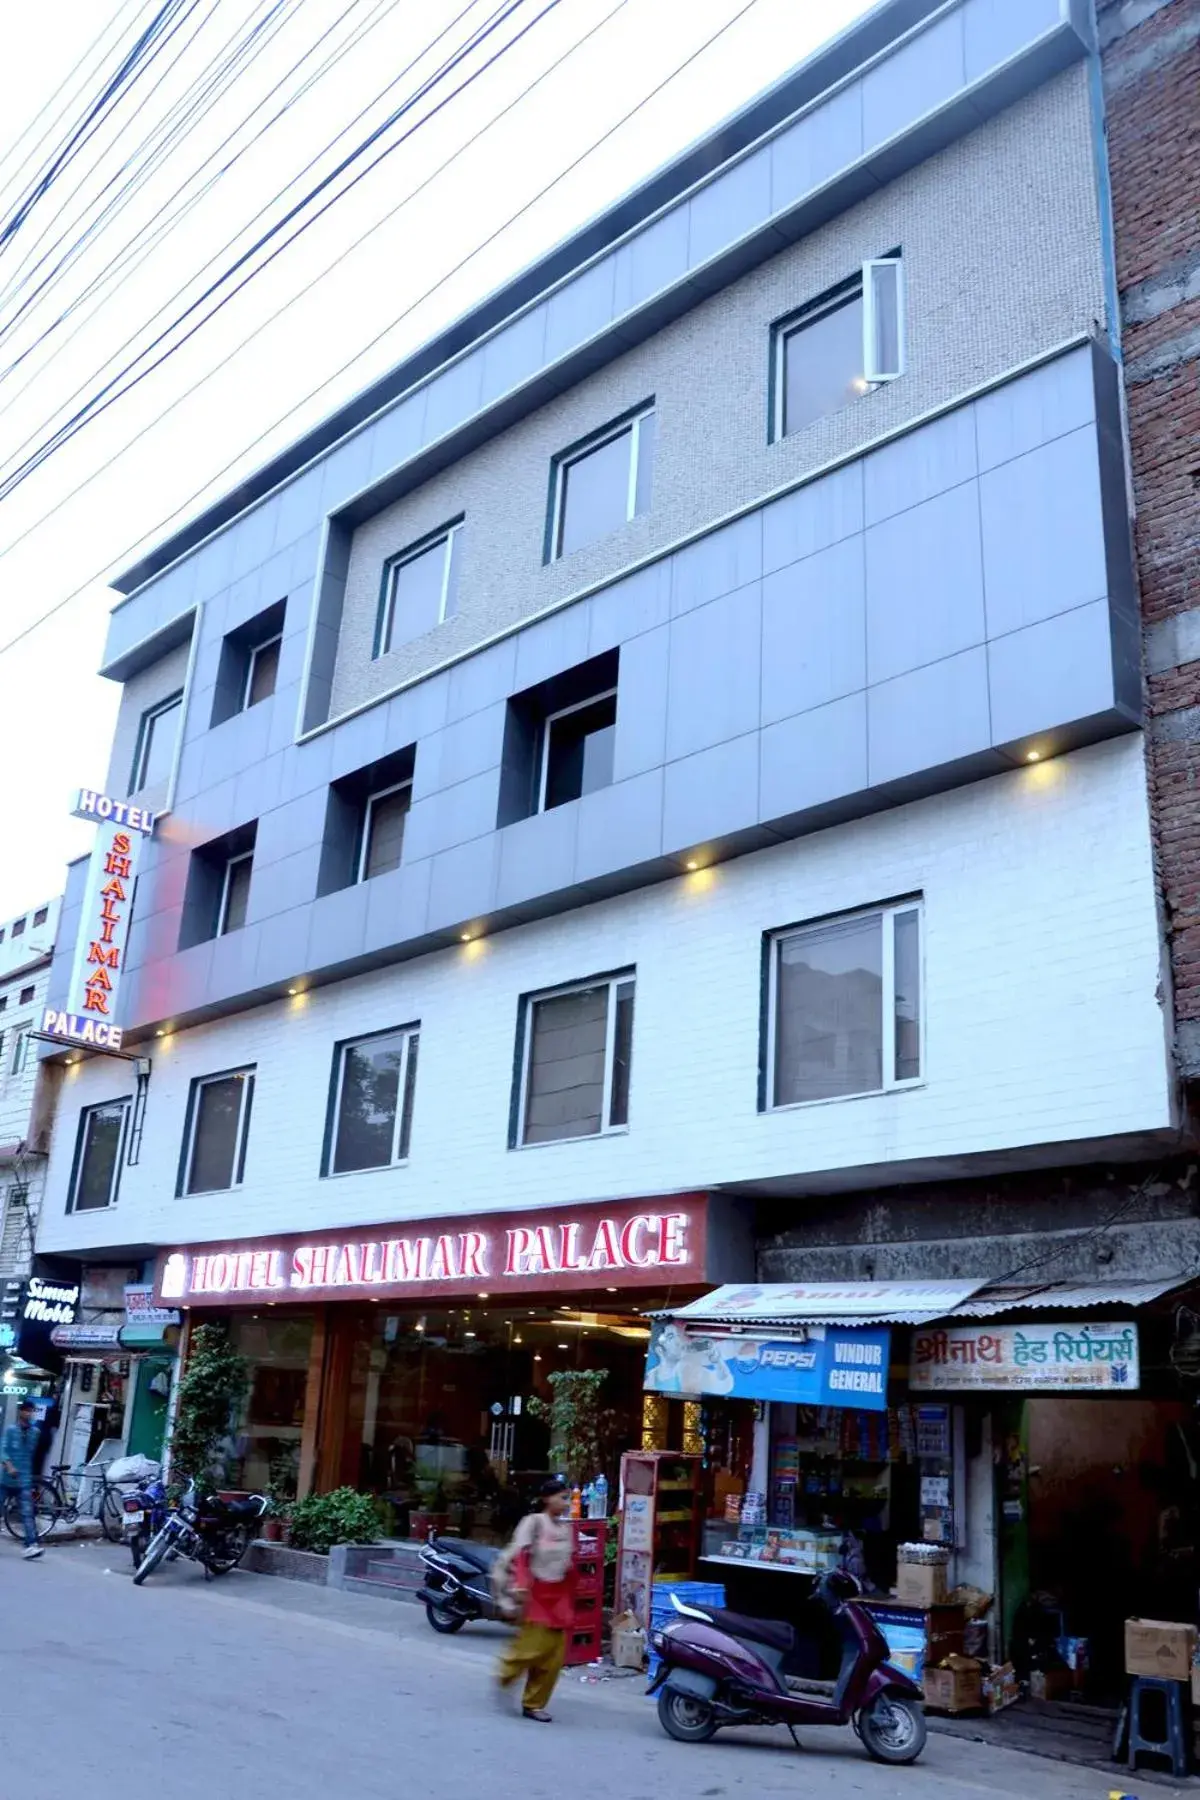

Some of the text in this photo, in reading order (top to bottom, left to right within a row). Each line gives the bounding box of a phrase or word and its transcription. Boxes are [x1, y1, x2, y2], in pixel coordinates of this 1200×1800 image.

[80, 788, 153, 832] HOTEL
[83, 831, 132, 1014] SHALIMAR
[43, 1010, 122, 1050] PALACE
[190, 1213, 688, 1292] HOTEL SHALIMAR PALACE
[760, 1349, 816, 1369] PEPSI
[914, 1326, 1134, 1366] श्रीनाथ हेड रिपेयर्स
[829, 1368, 883, 1393] GENERAL
